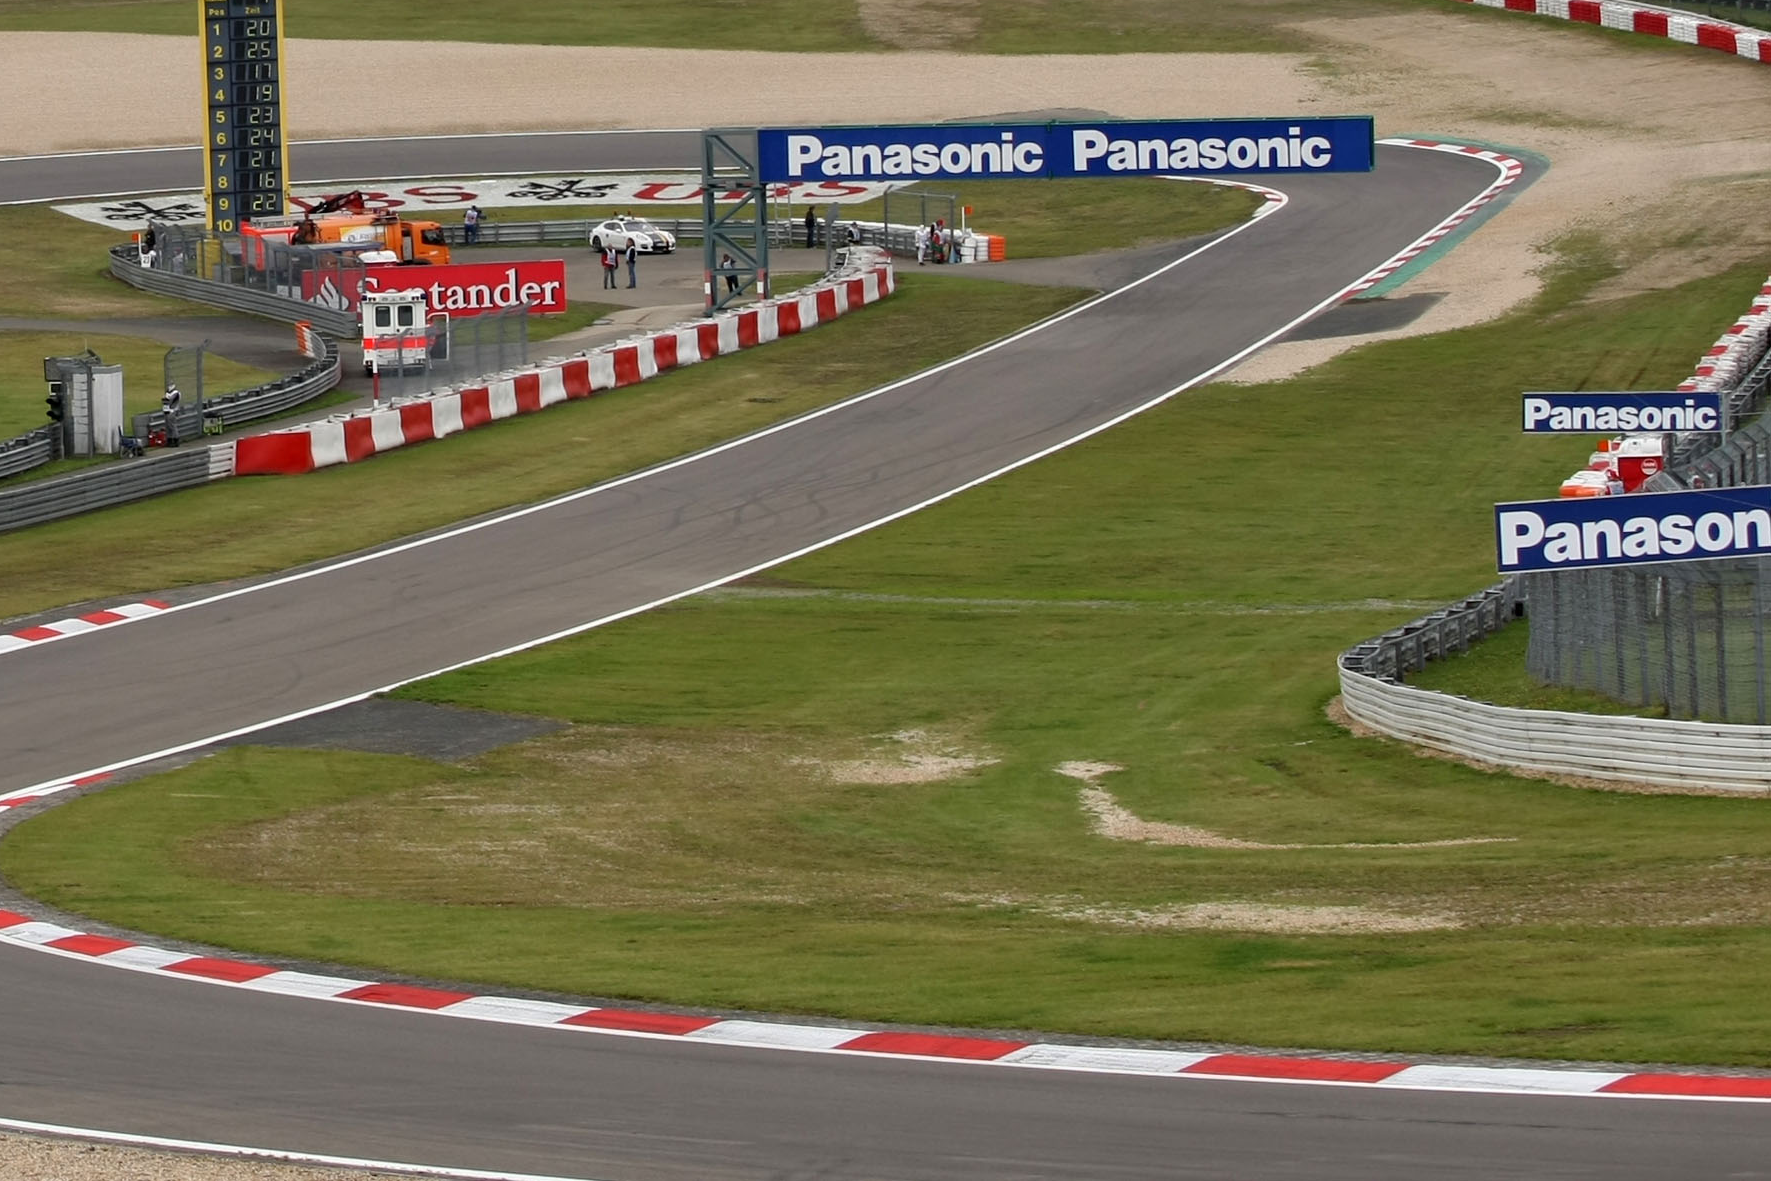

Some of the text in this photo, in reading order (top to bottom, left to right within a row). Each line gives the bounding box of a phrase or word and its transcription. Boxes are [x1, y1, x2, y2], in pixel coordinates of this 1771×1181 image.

[213, 20, 269, 36] 1 20
[213, 42, 270, 58] 2 25
[214, 63, 271, 80] 3 17
[215, 85, 272, 101] 4 19
[216, 107, 273, 123] 5 23
[216, 129, 274, 146] 6 24
[217, 151, 275, 167] 7 21
[787, 127, 1332, 177] Panasonic Panasonic
[218, 172, 275, 188] 8 16
[219, 194, 276, 210] 9 22
[288, 185, 478, 215] BS
[217, 219, 233, 231] 10
[356, 268, 560, 314] Stander
[1524, 398, 1716, 430] Panasonic
[1499, 508, 1771, 566] Panason
